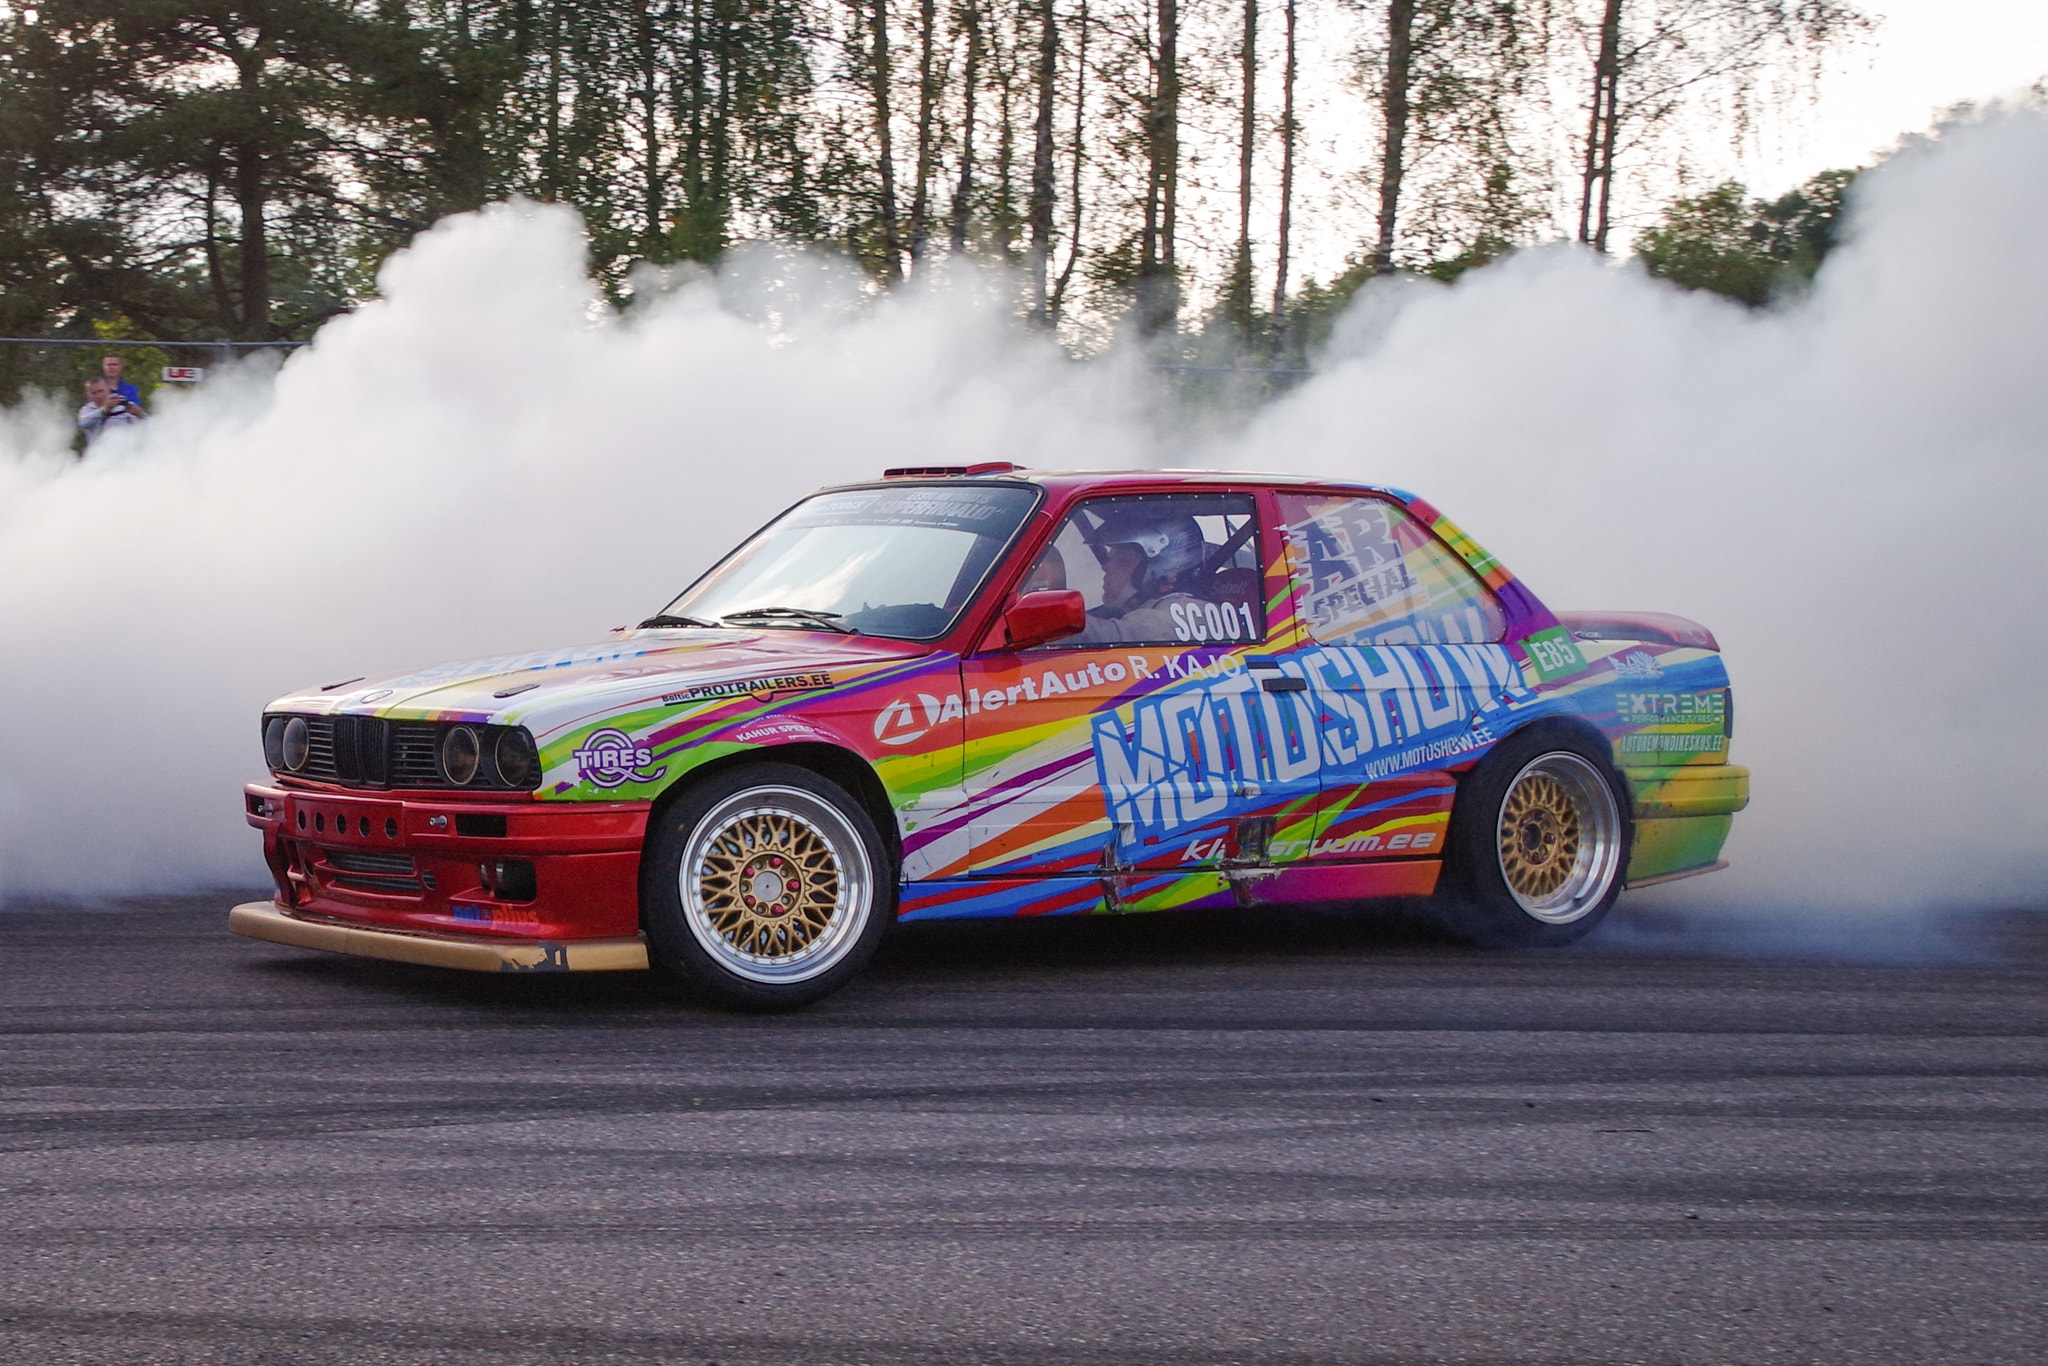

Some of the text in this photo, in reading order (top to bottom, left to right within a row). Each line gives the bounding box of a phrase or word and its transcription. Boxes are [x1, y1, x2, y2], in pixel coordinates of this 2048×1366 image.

[1300, 498, 1402, 597] AR
[1311, 563, 1418, 627] SPECIAL
[1127, 653, 1241, 680] R. KAJO
[1530, 636, 1577, 673] E85
[939, 661, 1127, 724] AlertAuto
[1616, 693, 1724, 714] EXTREME
[735, 724, 815, 742] KAHUR SPEED
[1093, 603, 1530, 846] MOTOSHOW
[1631, 714, 1712, 723] PERFORMANCE TYRES
[574, 748, 652, 769] TIRES
[1365, 727, 1497, 780] WWW.MOTOSHOW.EE
